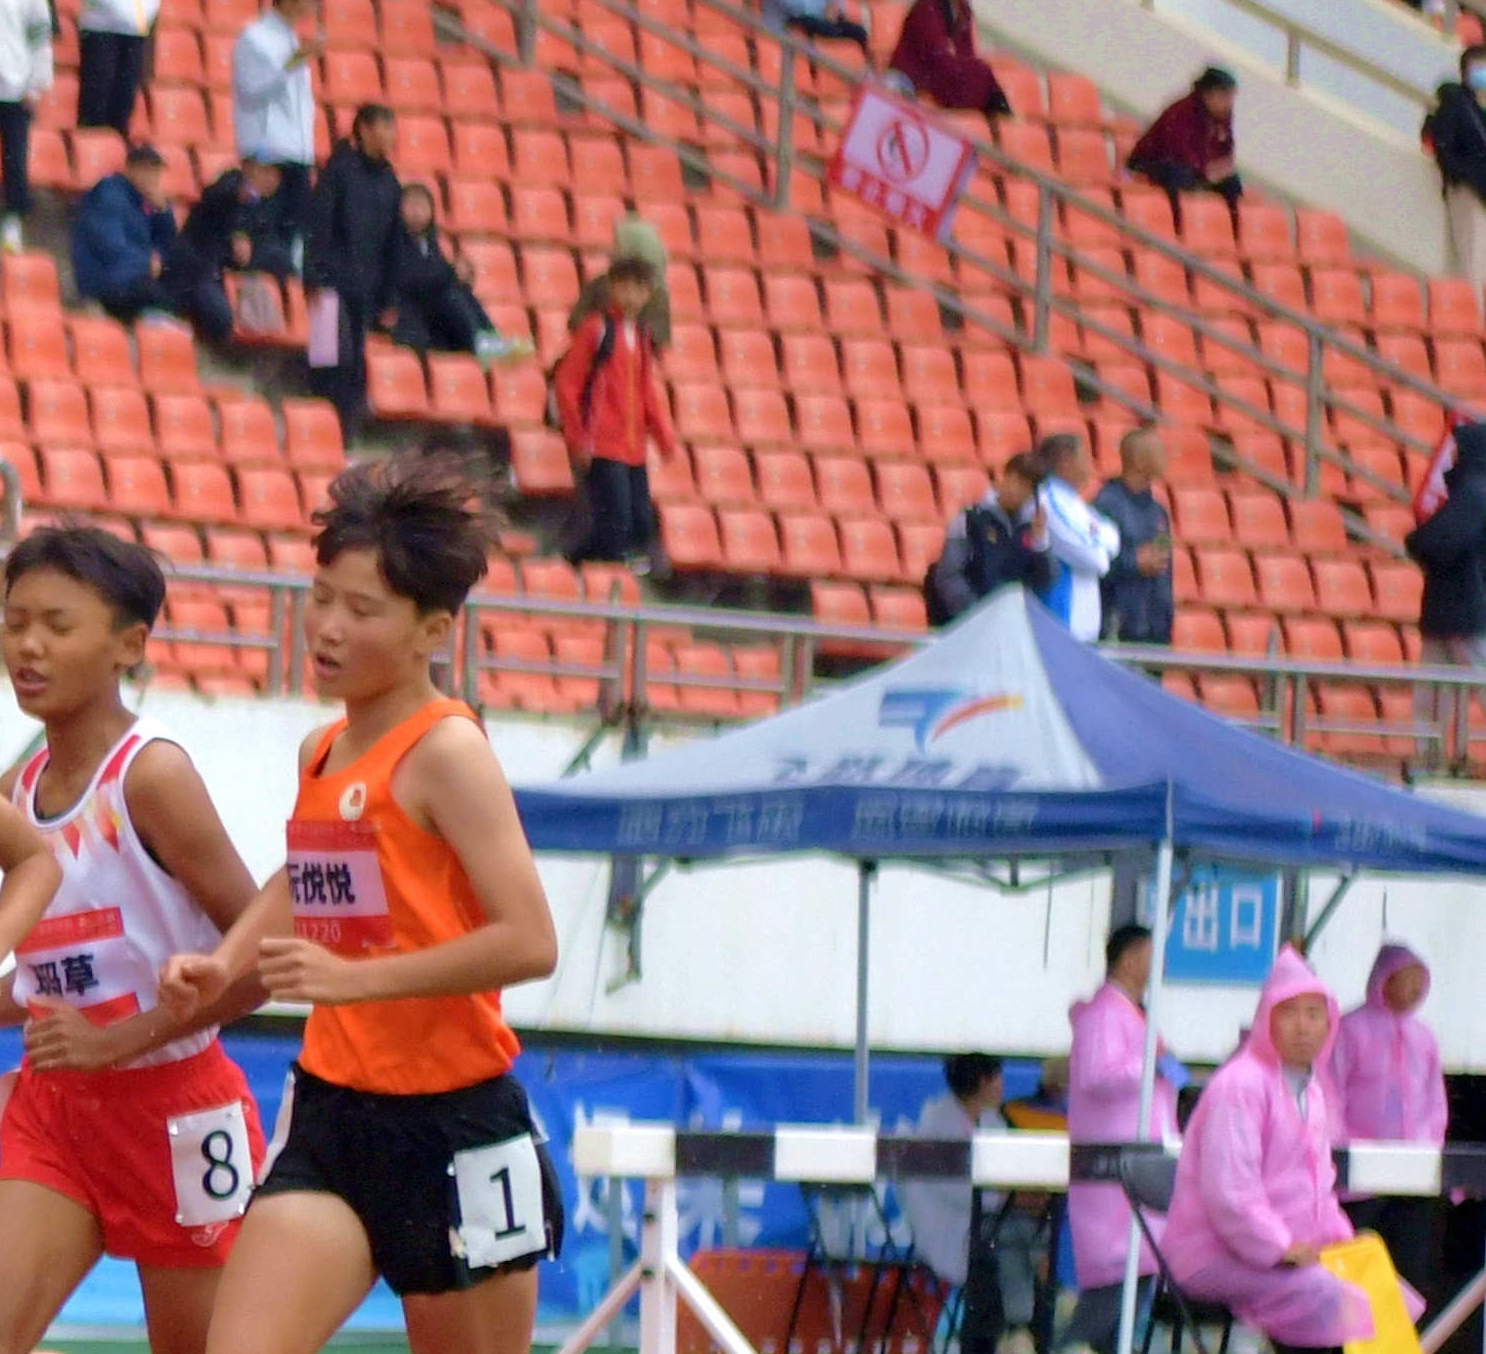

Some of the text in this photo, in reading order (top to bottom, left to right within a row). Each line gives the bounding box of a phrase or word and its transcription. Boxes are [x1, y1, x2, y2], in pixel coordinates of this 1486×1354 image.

[1183, 877, 1262, 952] 出口
[201, 1129, 238, 1202] 8
[488, 1168, 524, 1239] 1
